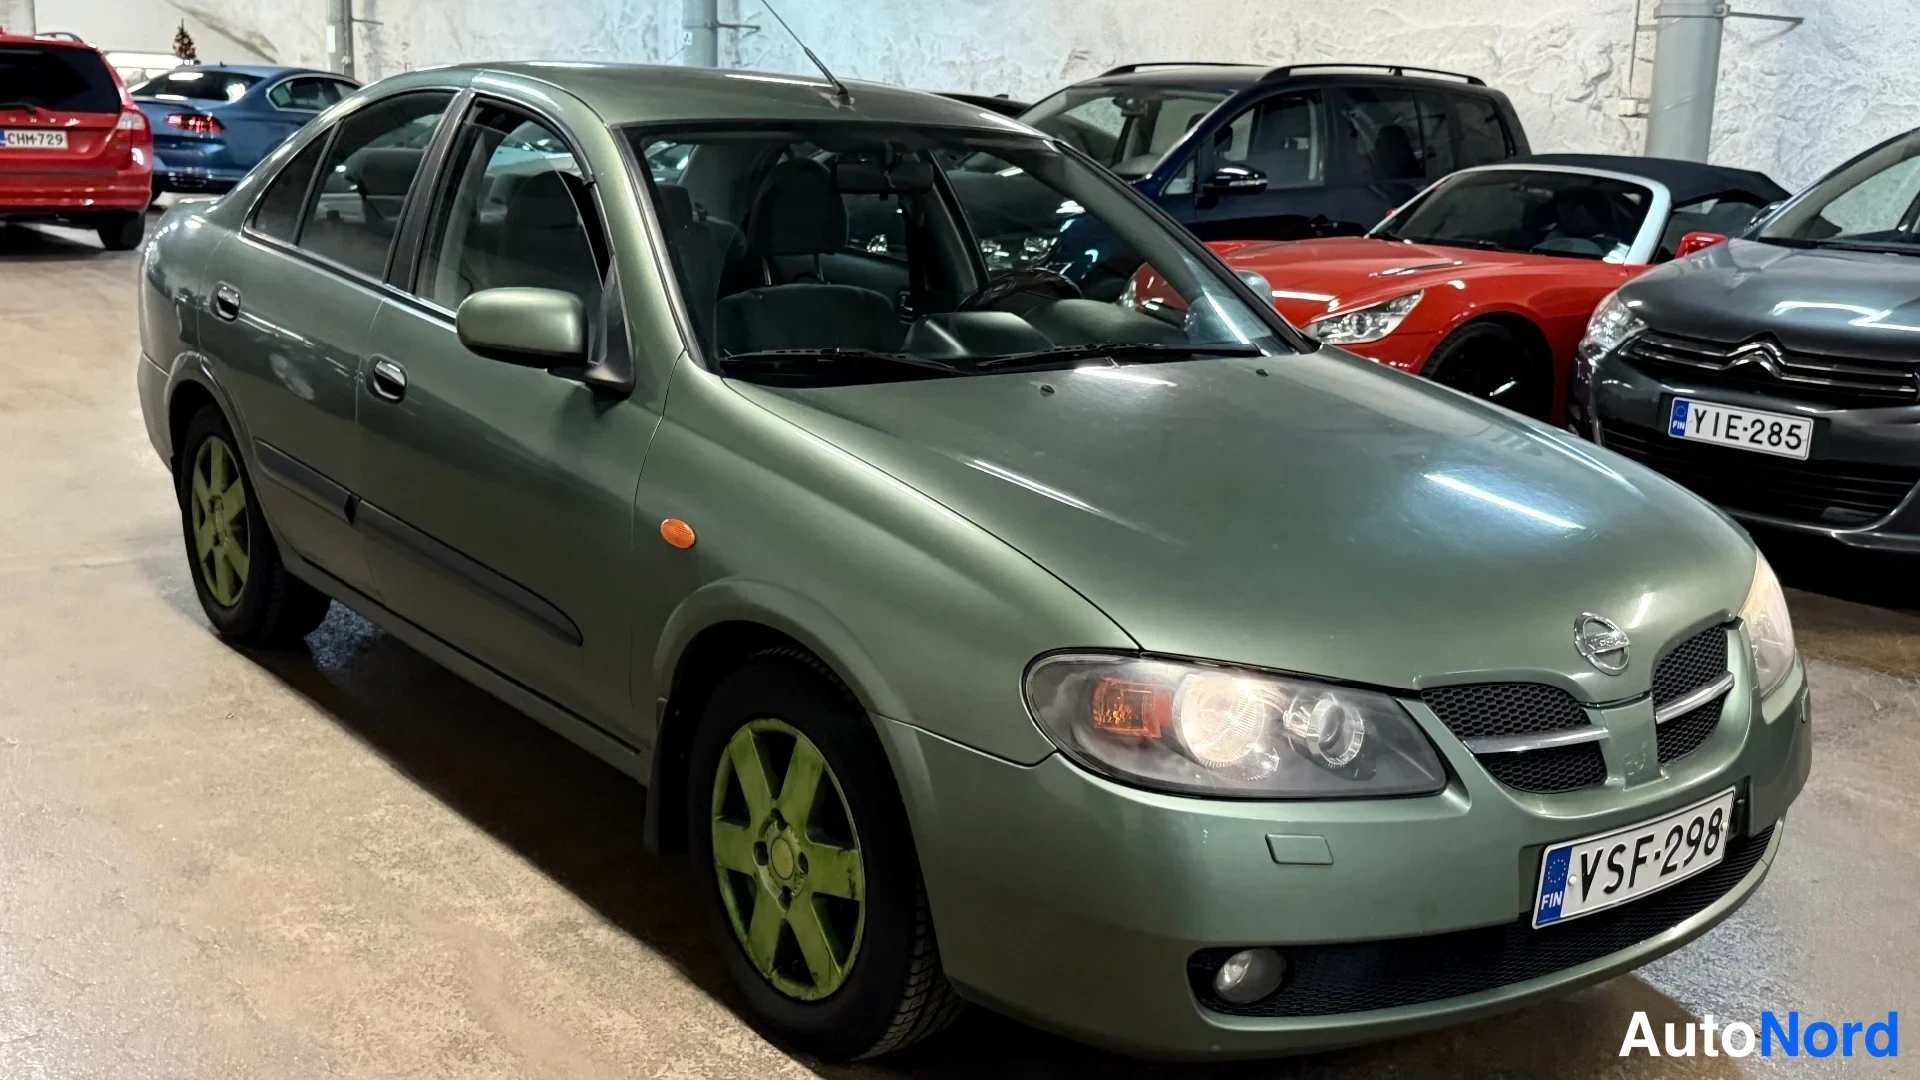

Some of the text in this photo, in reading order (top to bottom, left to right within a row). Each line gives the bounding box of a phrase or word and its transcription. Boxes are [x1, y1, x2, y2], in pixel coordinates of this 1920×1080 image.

[7, 132, 64, 145] CHM-729
[1672, 420, 1685, 430] FIN
[1694, 408, 1802, 450] YIE-285
[1581, 807, 1723, 903] VSF-298
[1540, 890, 1563, 911] FIN
